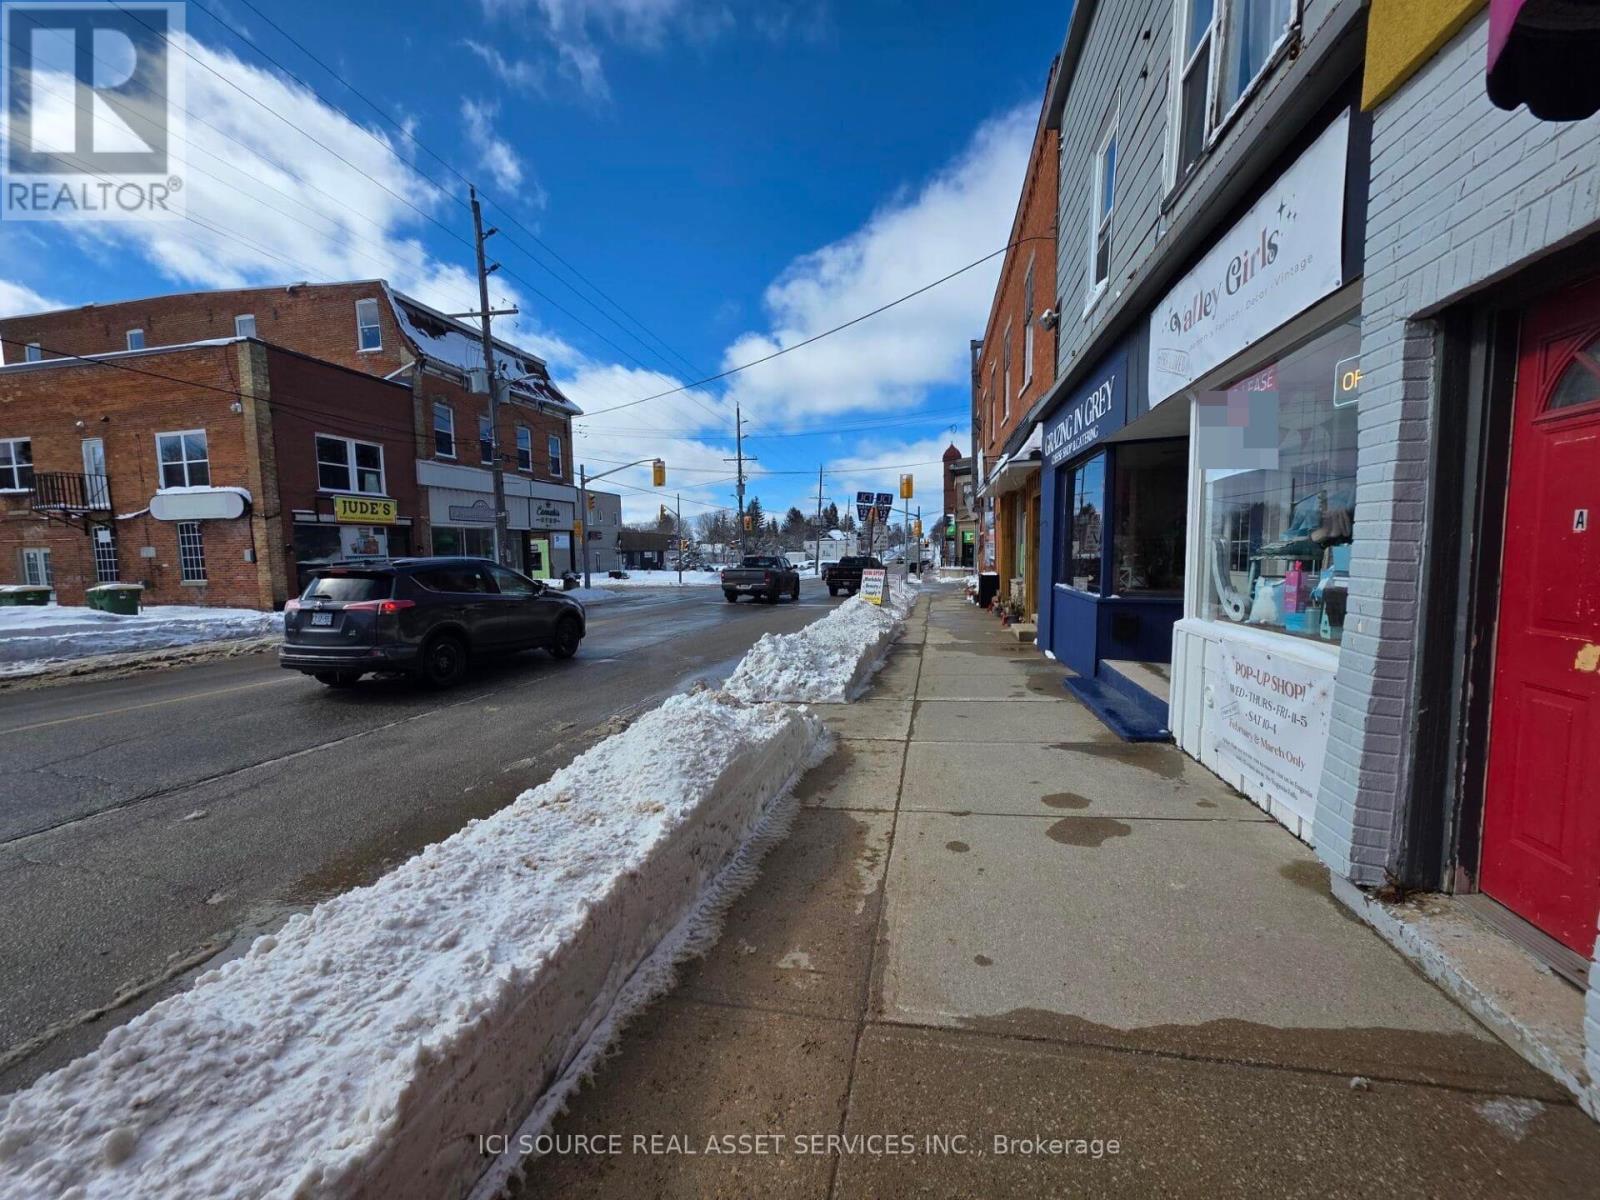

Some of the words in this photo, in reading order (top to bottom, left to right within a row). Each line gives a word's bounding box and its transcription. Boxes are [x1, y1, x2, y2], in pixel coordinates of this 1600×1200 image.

[1225, 227, 1279, 294] Girls
[1045, 414, 1073, 457] GRAZING
[1084, 375, 1115, 426] GREY
[342, 500, 391, 516] JUDE'S
[1575, 510, 1584, 529] A
[1235, 661, 1271, 687] POP-UP
[1271, 675, 1307, 702] SHOP!
[1260, 736, 1285, 759] March
[1286, 750, 1306, 772] Only
